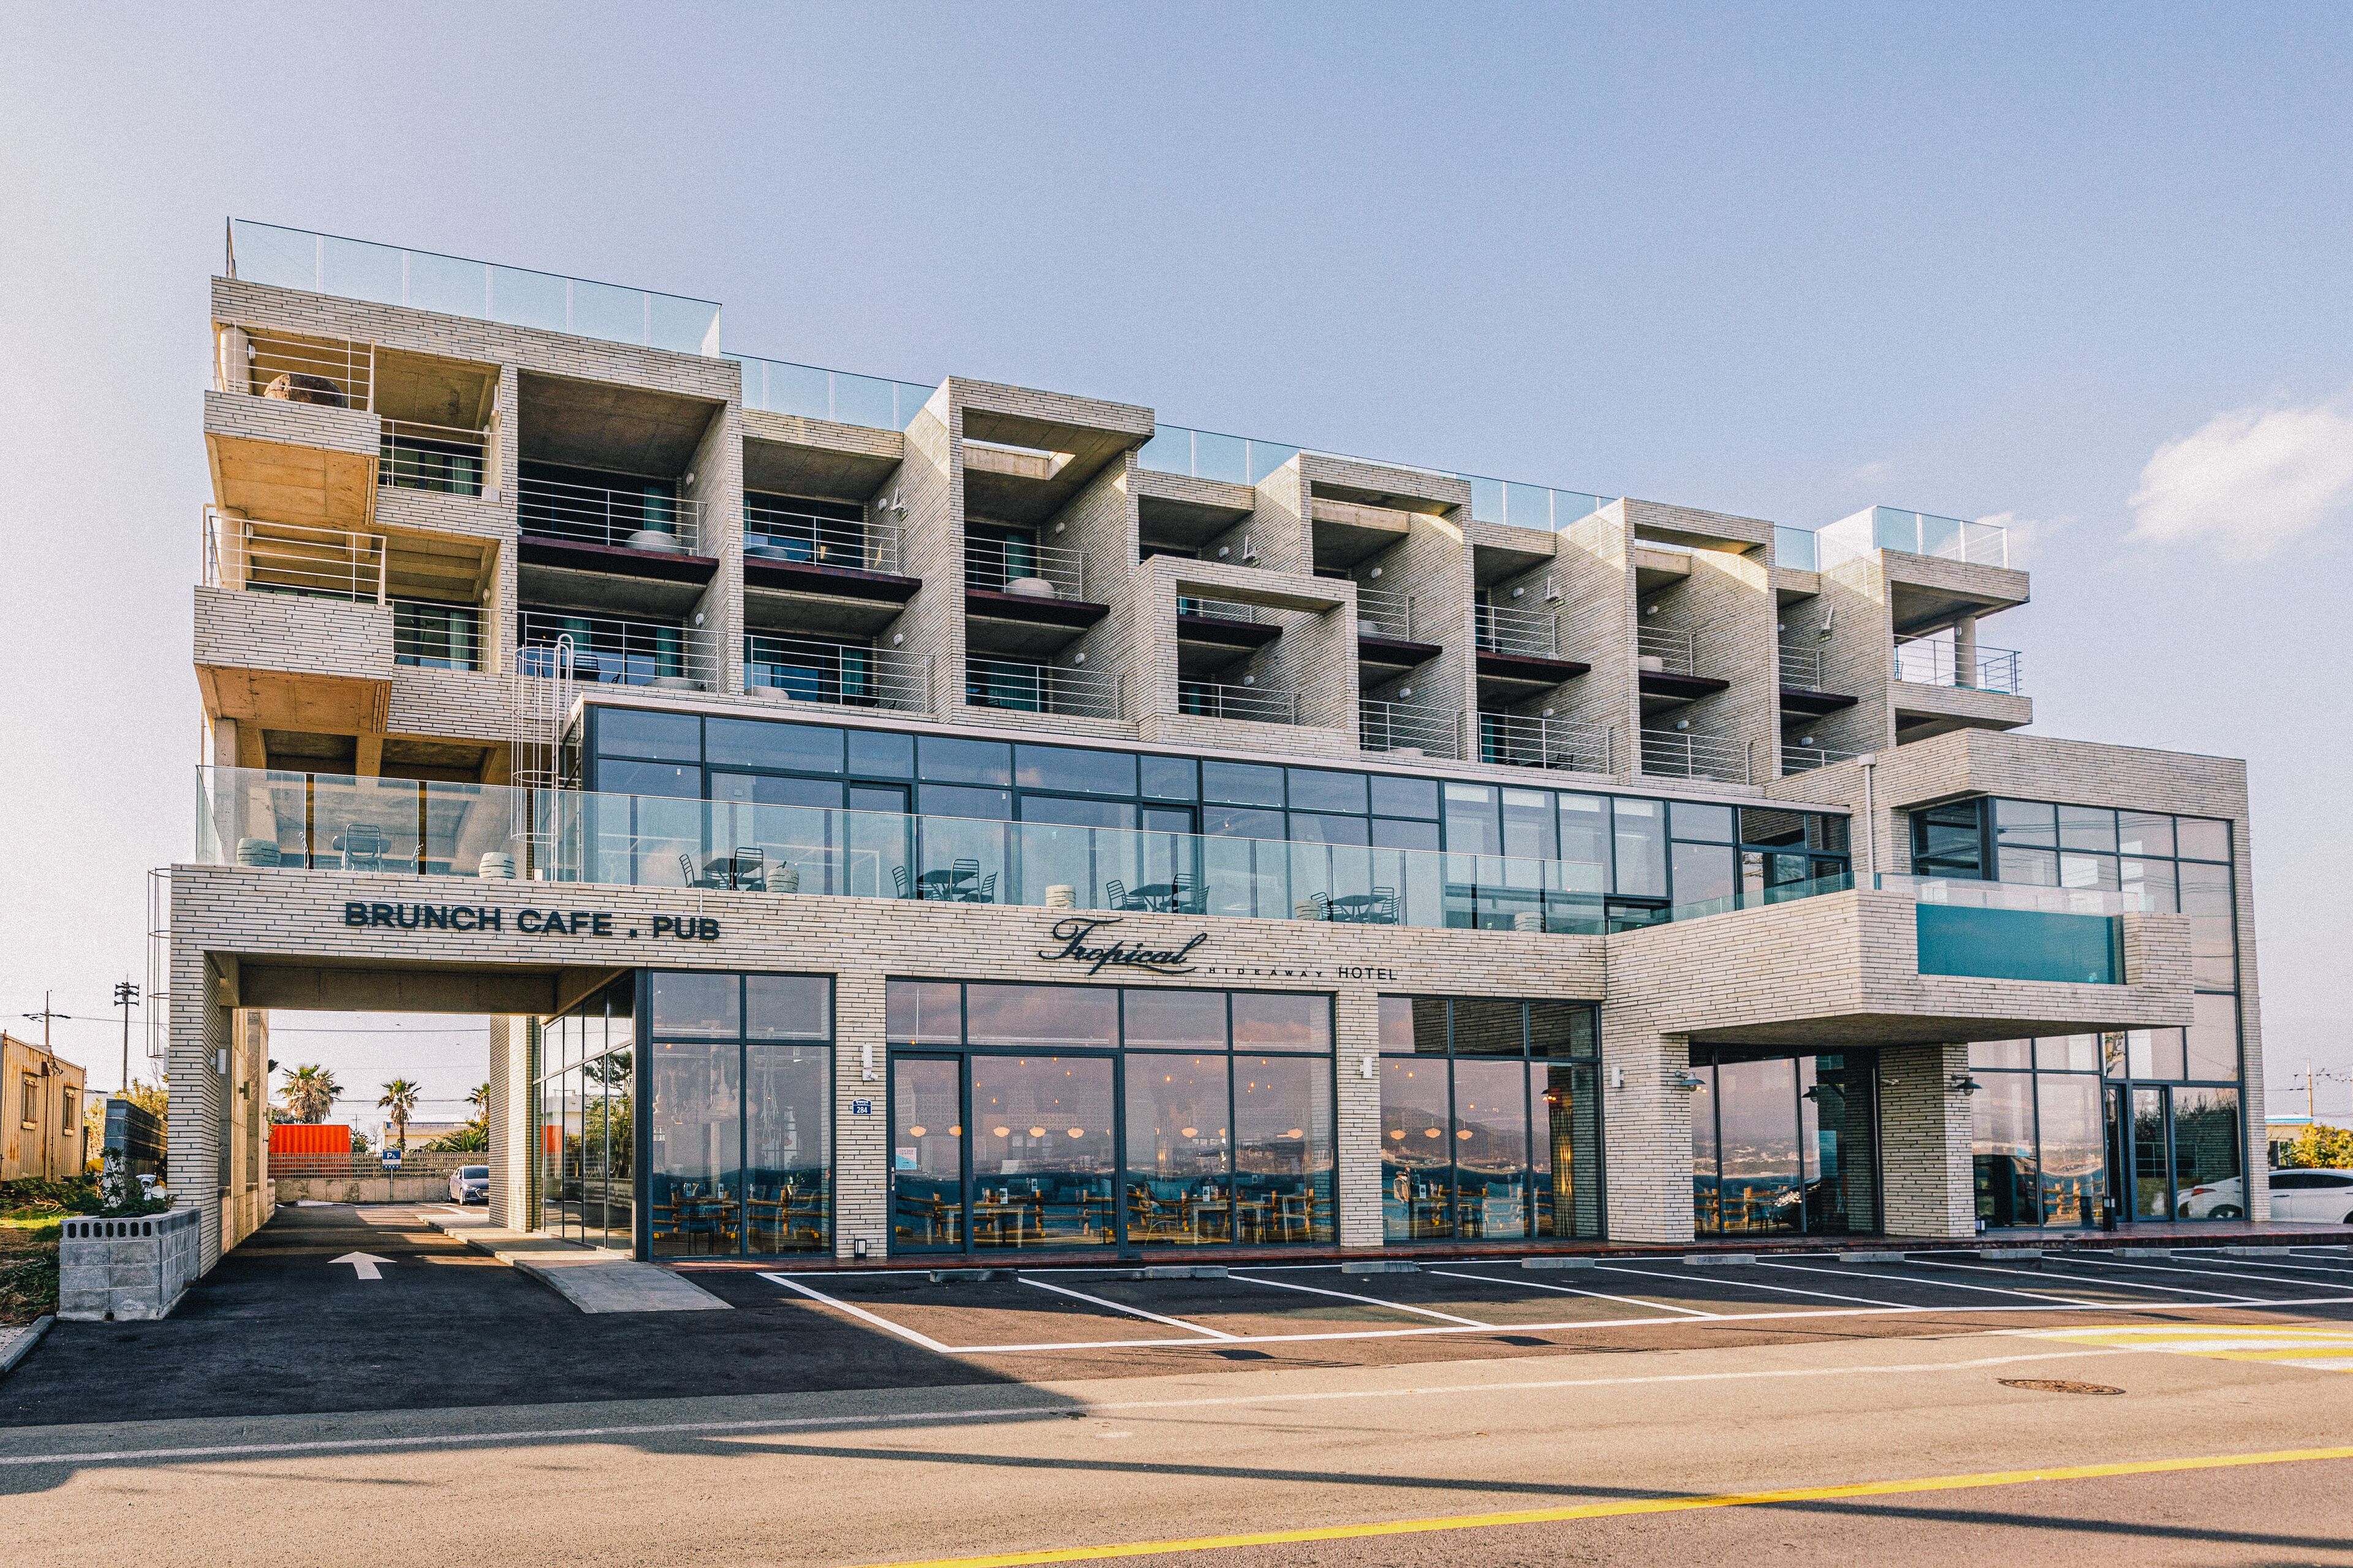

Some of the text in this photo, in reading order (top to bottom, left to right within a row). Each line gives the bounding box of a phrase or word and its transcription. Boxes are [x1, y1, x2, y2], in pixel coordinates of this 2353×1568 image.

[345, 902, 501, 932] BRUNCH
[517, 909, 613, 937] CAFE
[653, 916, 721, 941] PUB
[1038, 917, 1208, 977] Tropical
[1209, 966, 1398, 981] HIDEAWAY HOTEL
